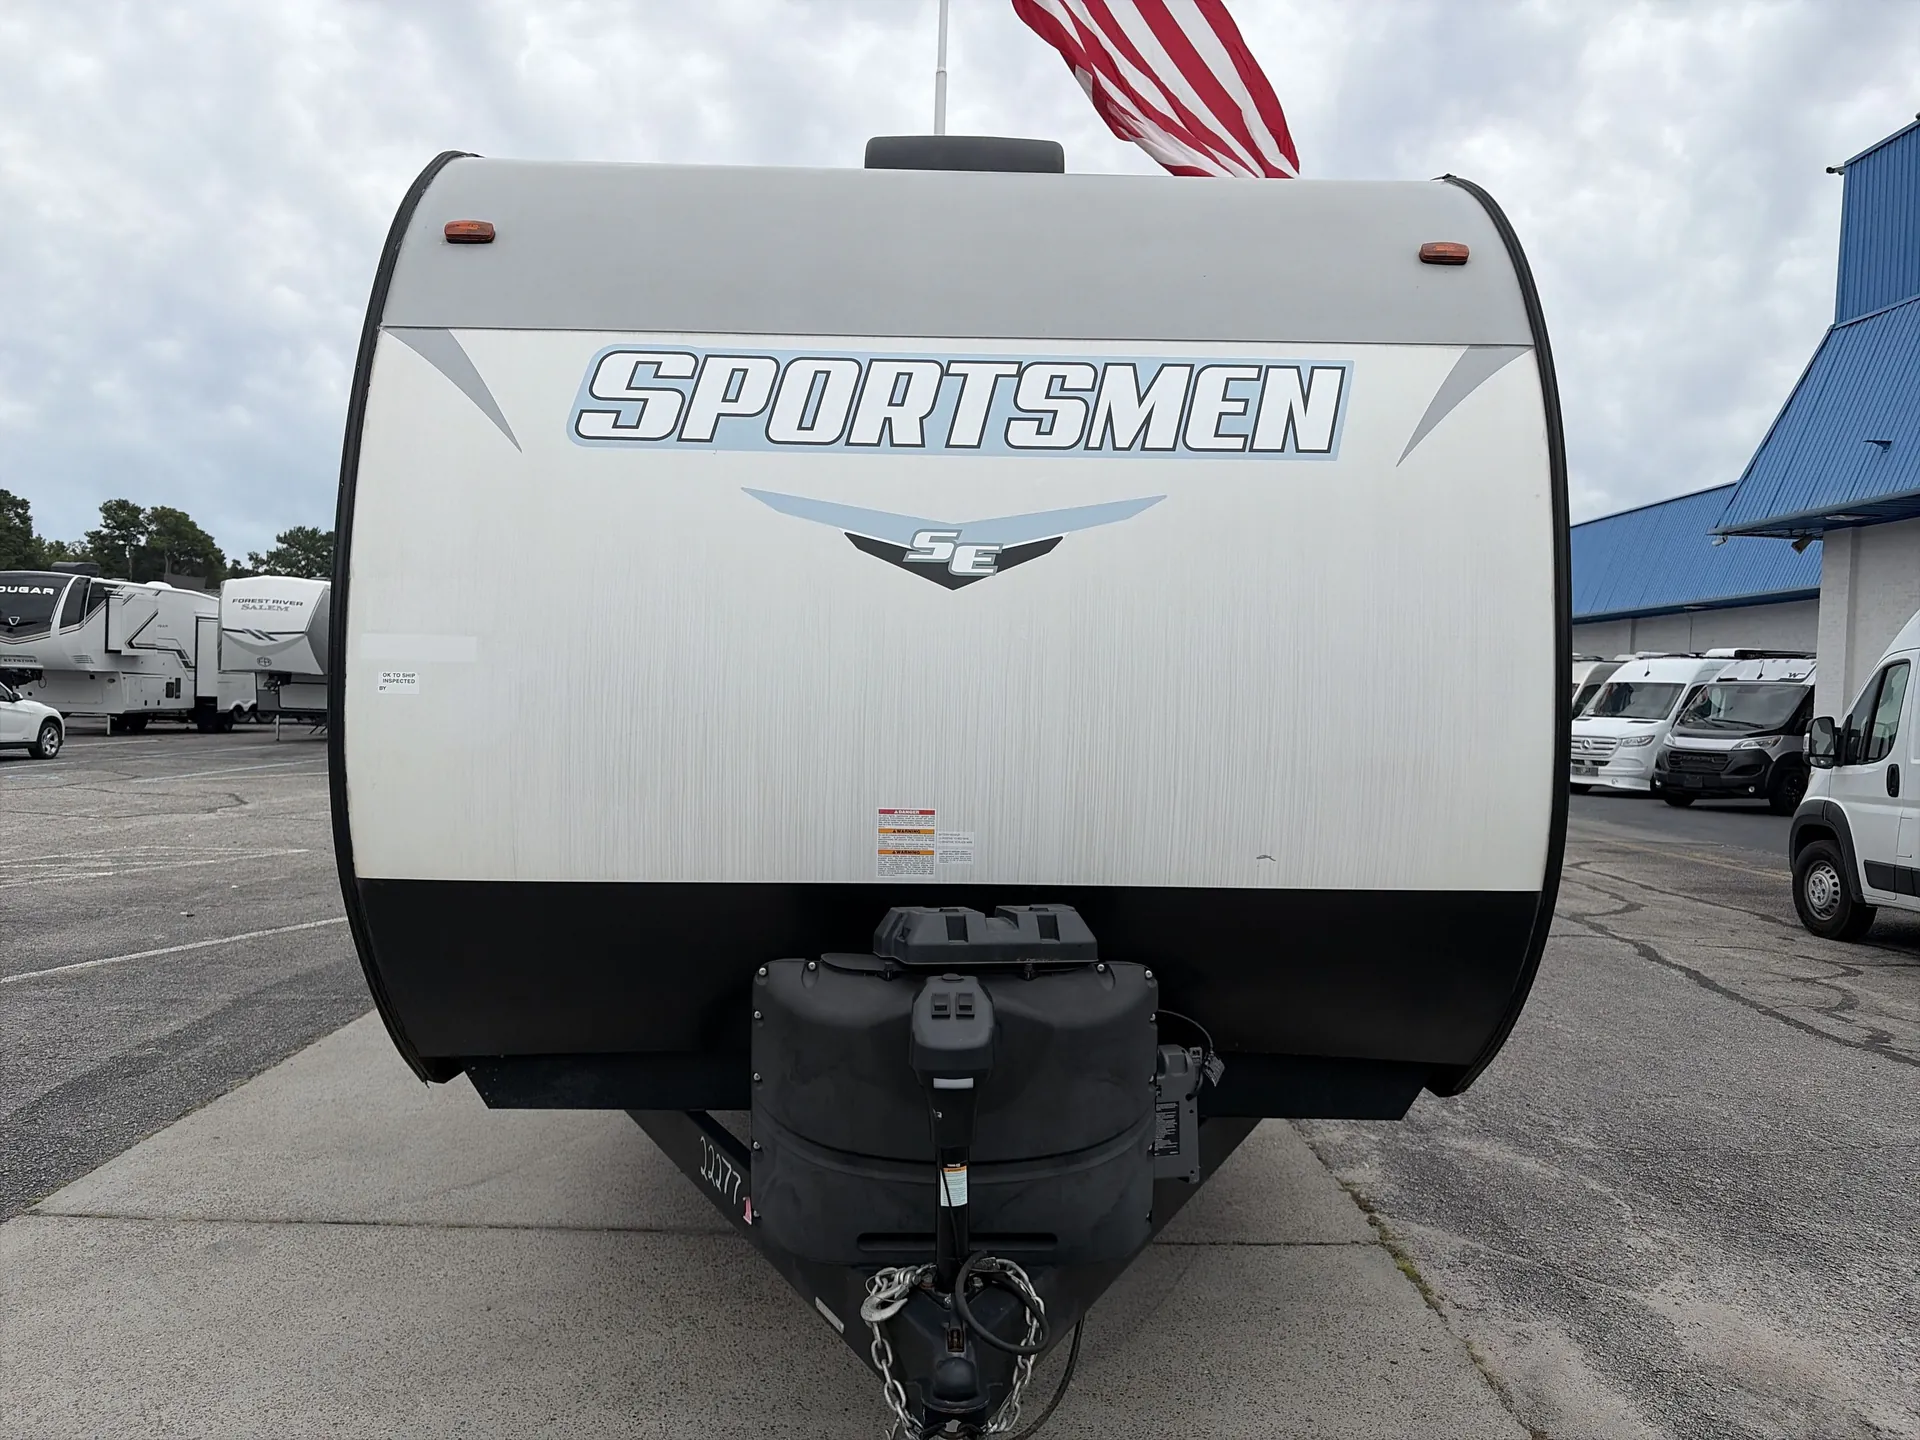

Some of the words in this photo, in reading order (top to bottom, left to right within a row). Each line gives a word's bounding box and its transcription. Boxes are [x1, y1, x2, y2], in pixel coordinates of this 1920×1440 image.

[574, 349, 1347, 454] SPORTSMEN
[903, 528, 1004, 577] SE
[241, 604, 290, 612] SALEM
[700, 1135, 742, 1205] 22277
